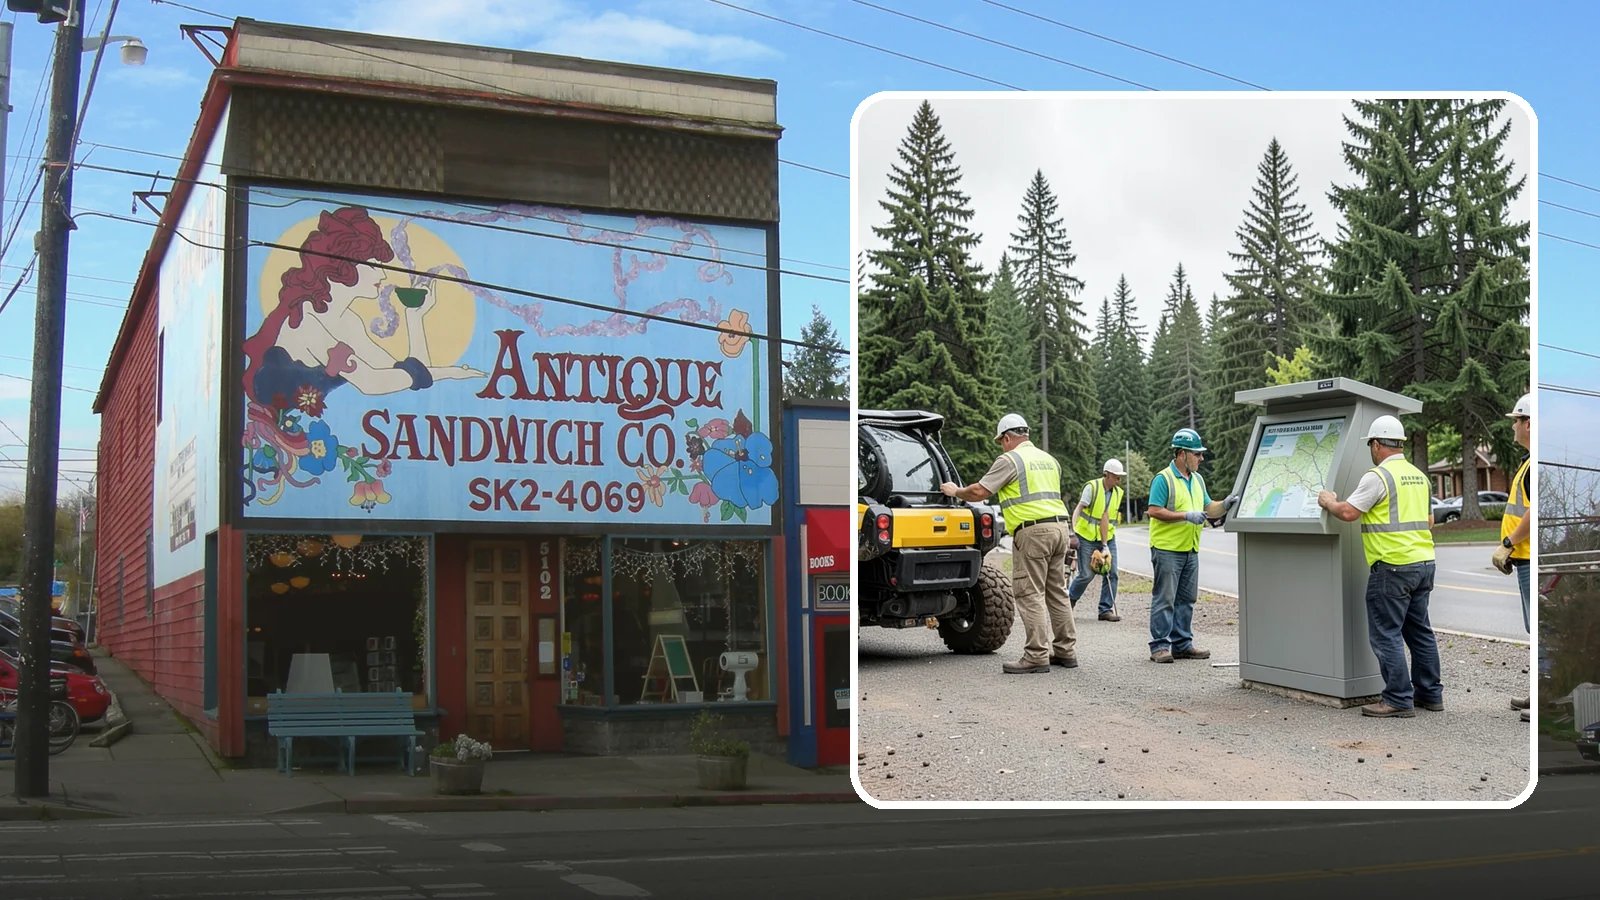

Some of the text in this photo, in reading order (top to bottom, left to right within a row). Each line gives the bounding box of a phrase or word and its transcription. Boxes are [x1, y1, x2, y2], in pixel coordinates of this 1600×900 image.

[477, 329, 723, 420] ANTIQUE
[361, 408, 685, 469] SANDWICH CO.
[468, 477, 646, 513] SK2-4069
[539, 541, 551, 600] 5102
[809, 555, 835, 569] BOOKS
